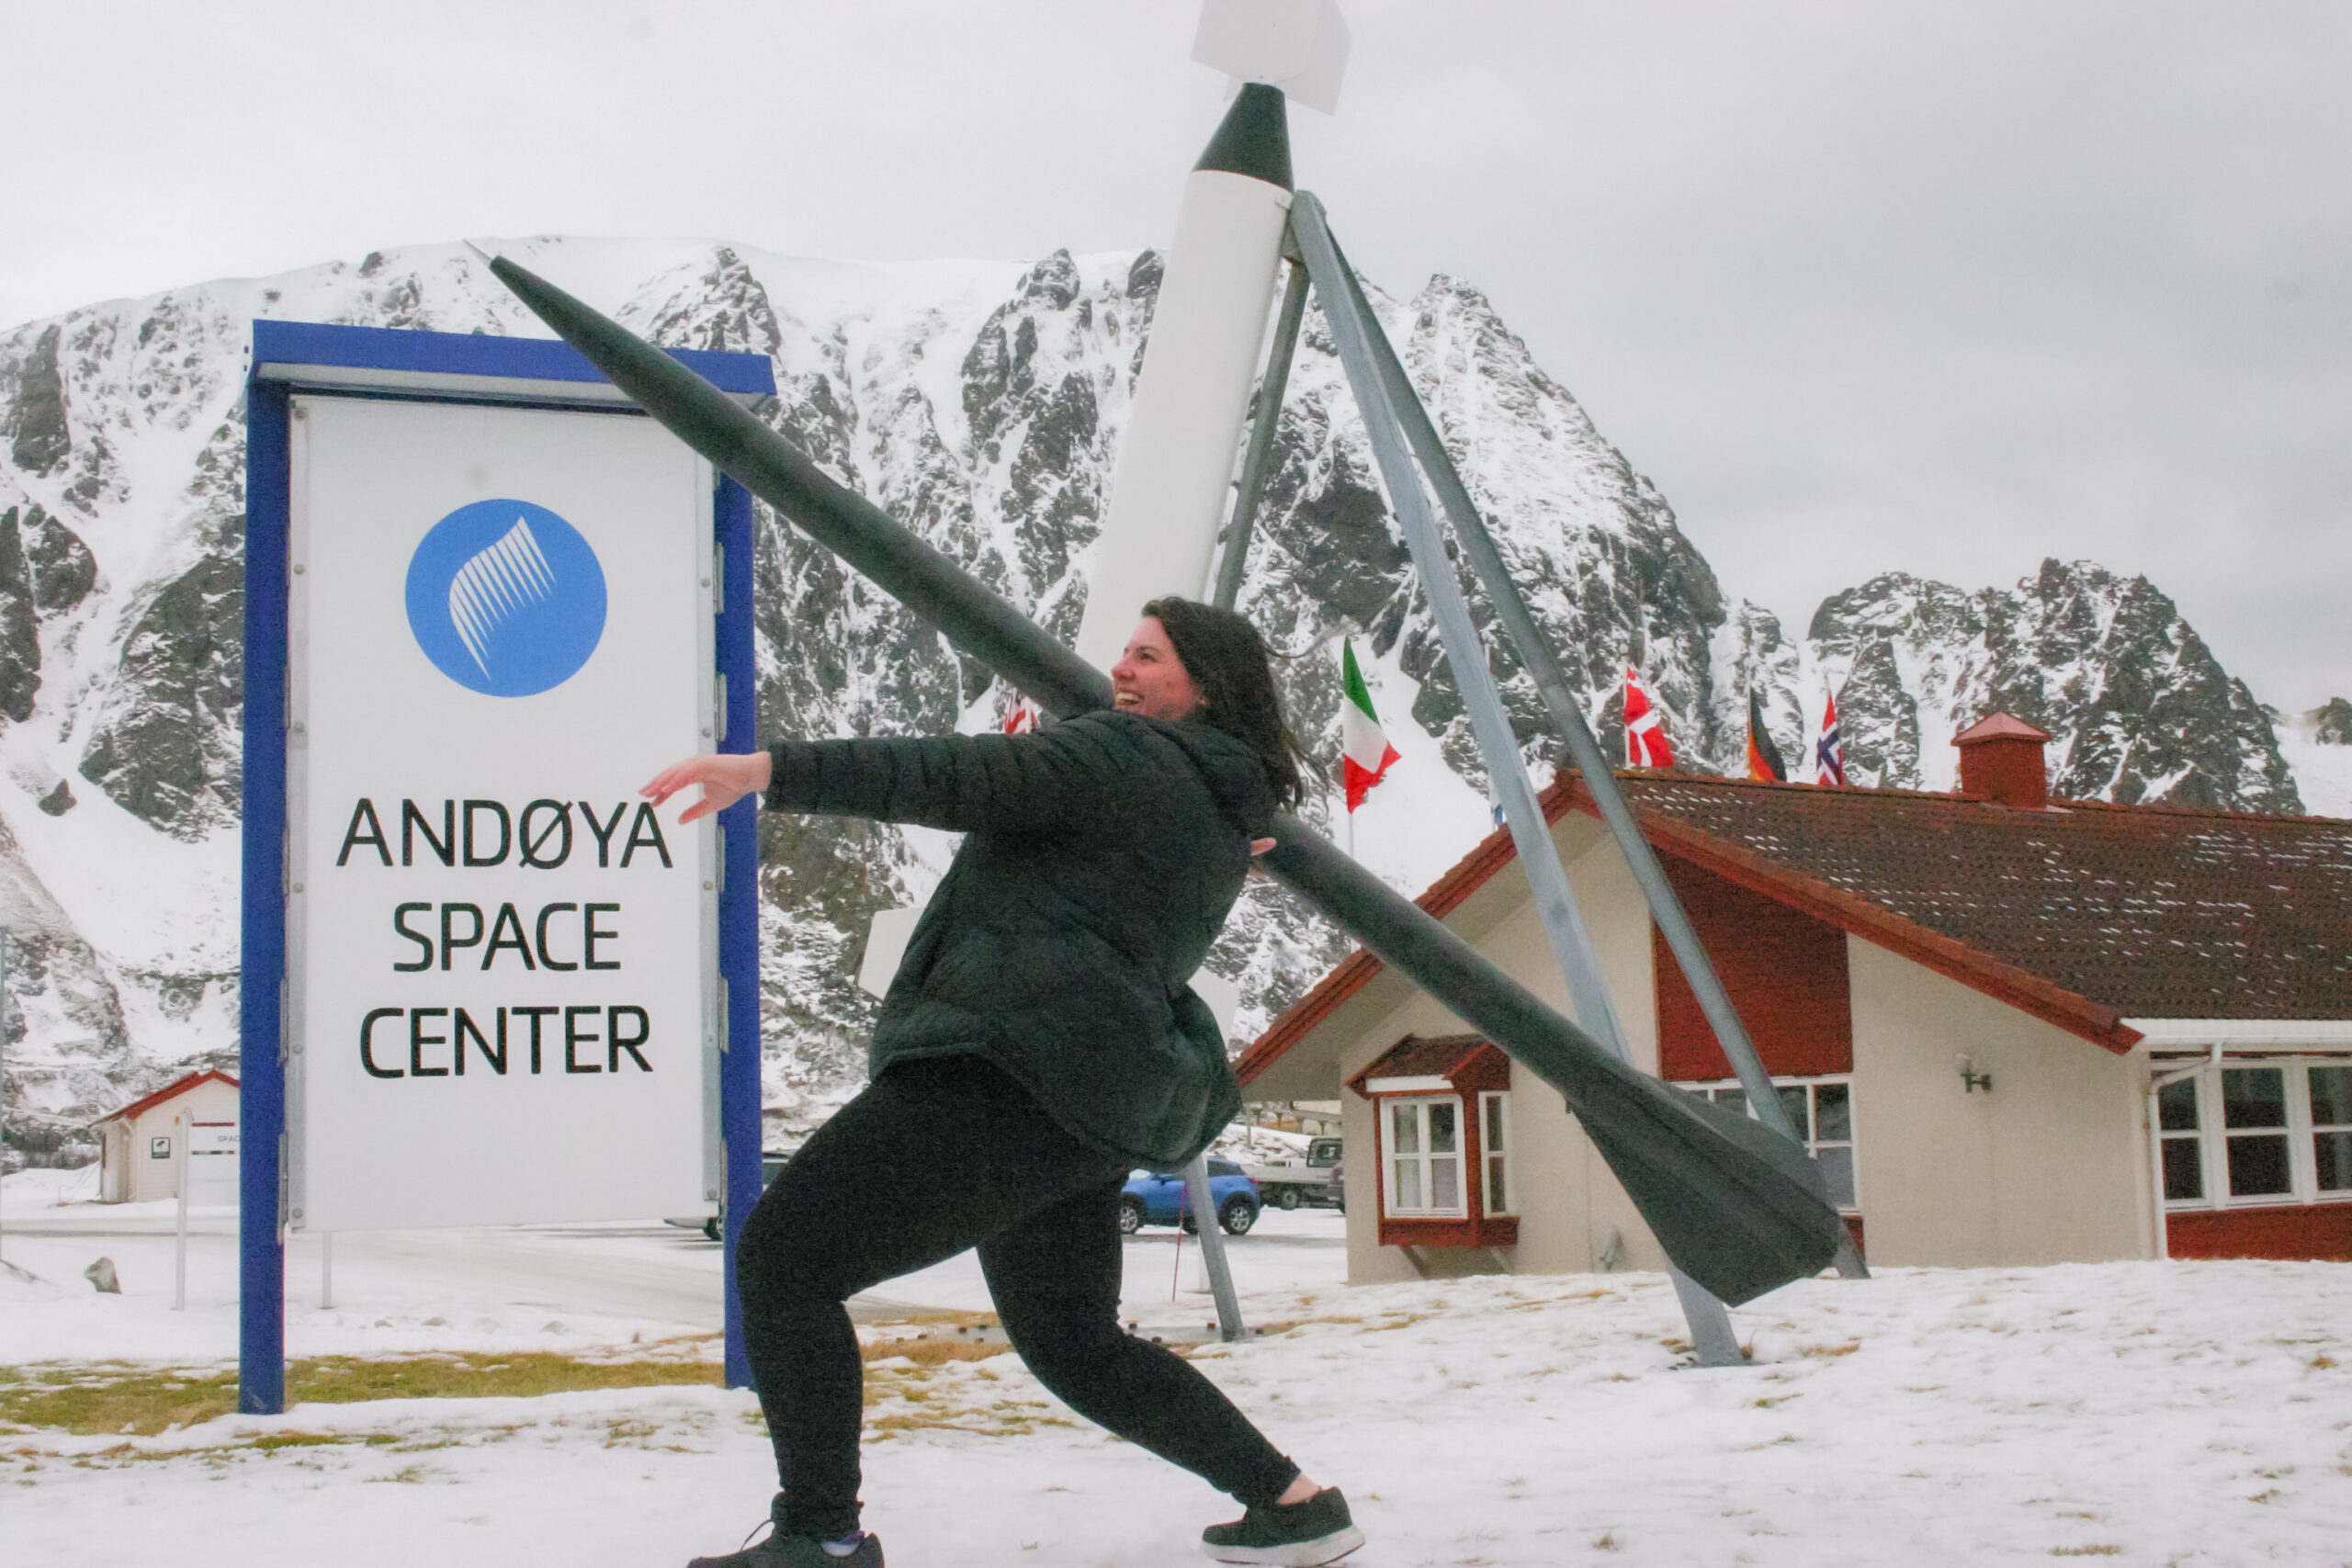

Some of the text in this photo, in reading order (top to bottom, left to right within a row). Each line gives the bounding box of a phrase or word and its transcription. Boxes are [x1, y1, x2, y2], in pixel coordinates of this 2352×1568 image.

[336, 797, 673, 870] ANDØYA
[393, 902, 621, 973] SPACE
[360, 1005, 653, 1079] CENTER
